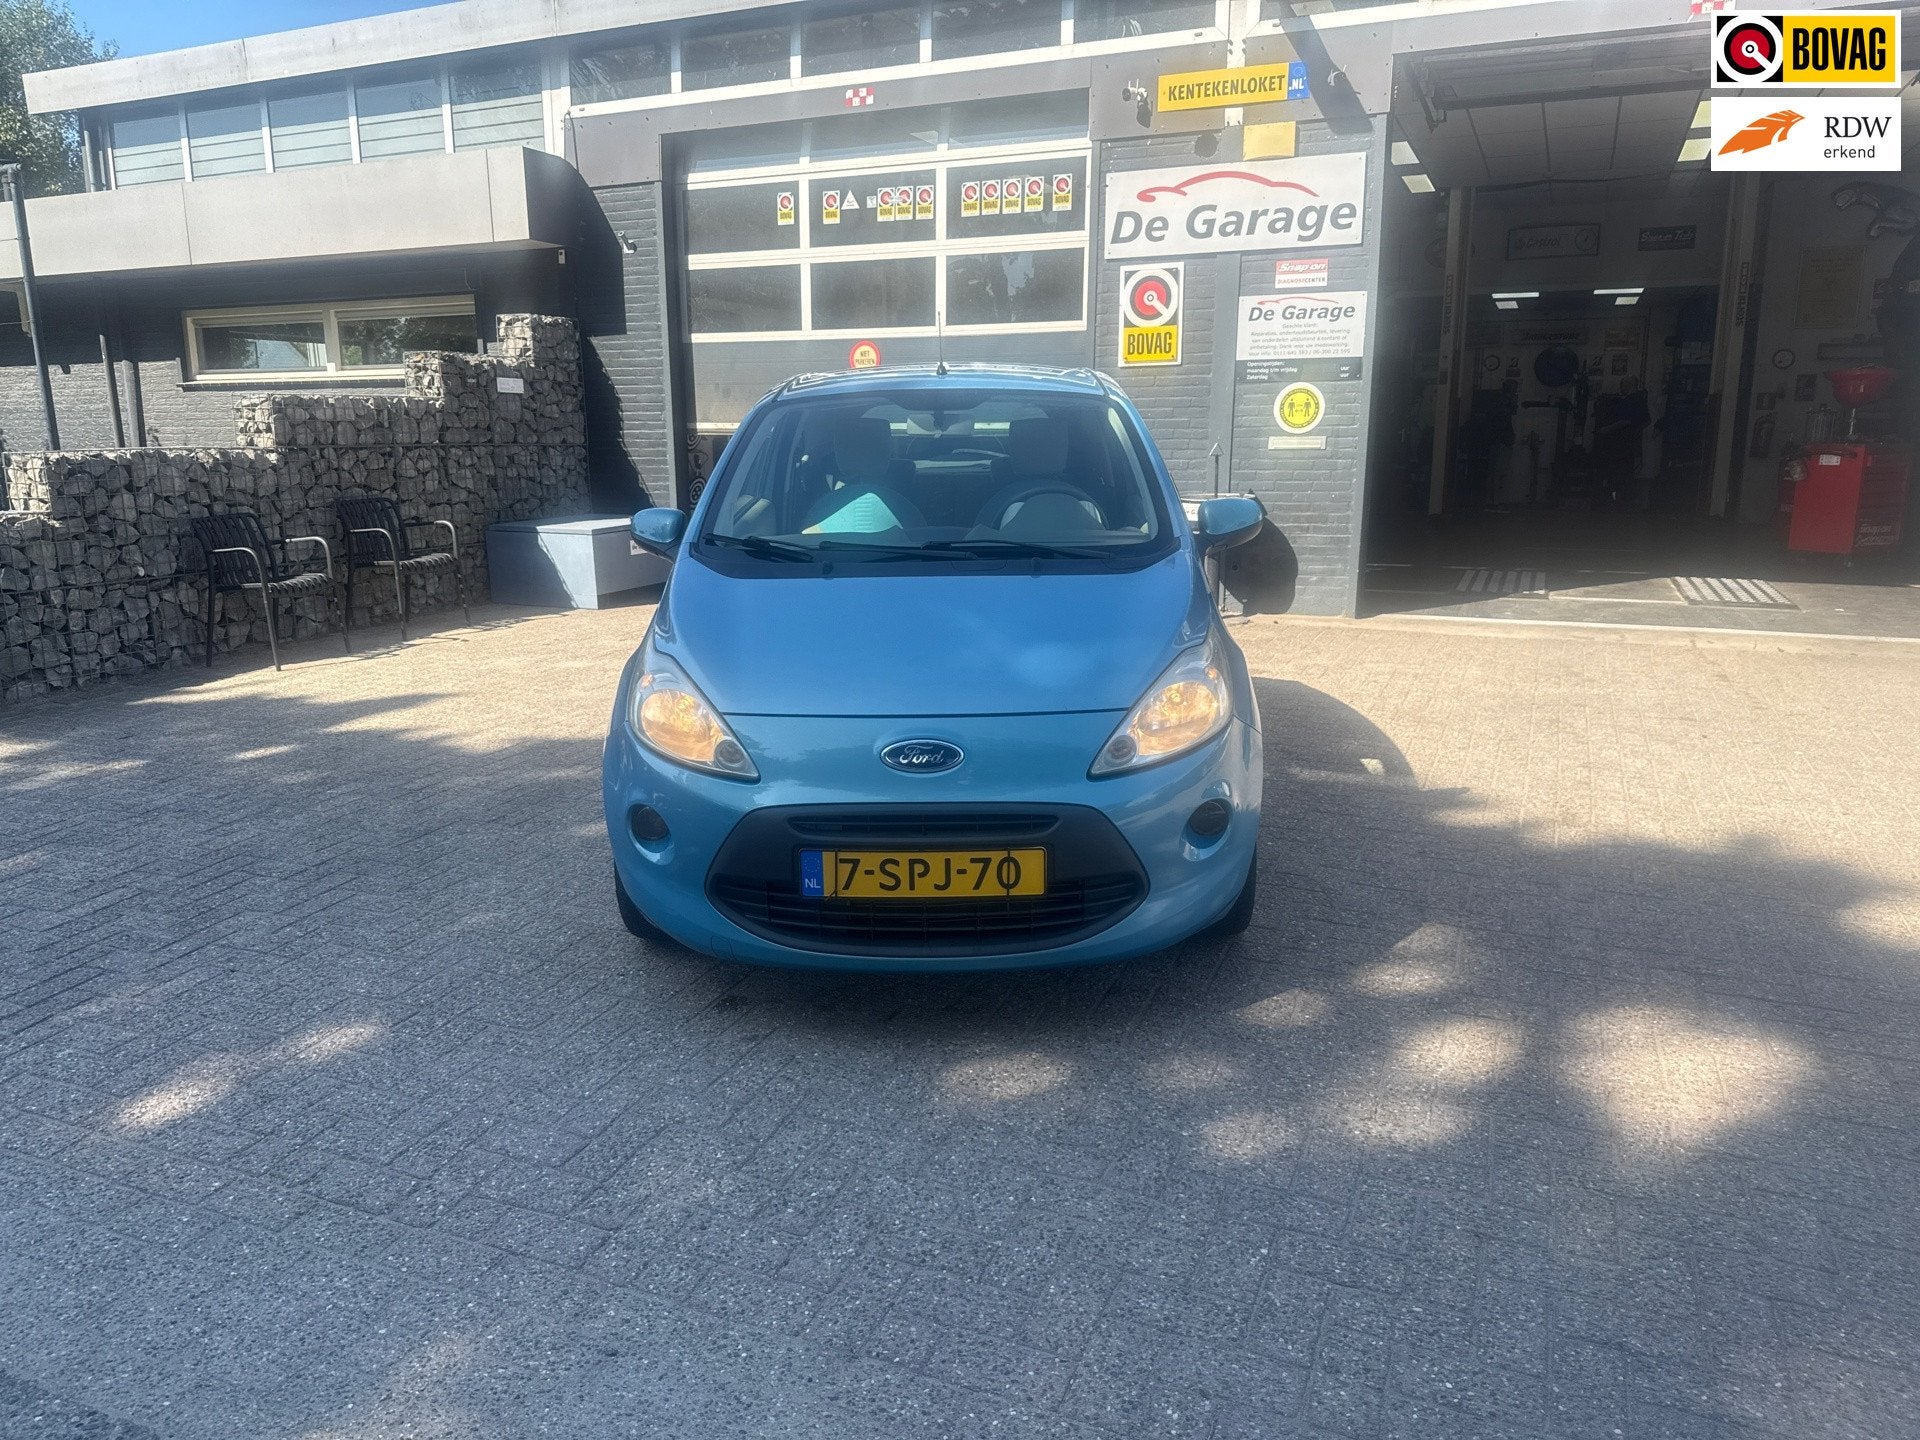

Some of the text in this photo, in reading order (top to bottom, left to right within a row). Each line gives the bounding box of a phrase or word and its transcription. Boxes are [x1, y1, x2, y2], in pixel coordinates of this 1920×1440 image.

[1168, 74, 1286, 101] KENTEKENLOKET
[1110, 202, 1357, 244] De Garage
[1279, 262, 1326, 273] Snap-on
[1248, 305, 1356, 322] De Garage
[1127, 332, 1172, 355] BOVAG
[899, 744, 944, 764] Ford
[805, 856, 1022, 891] NL 7-SPJ-70
